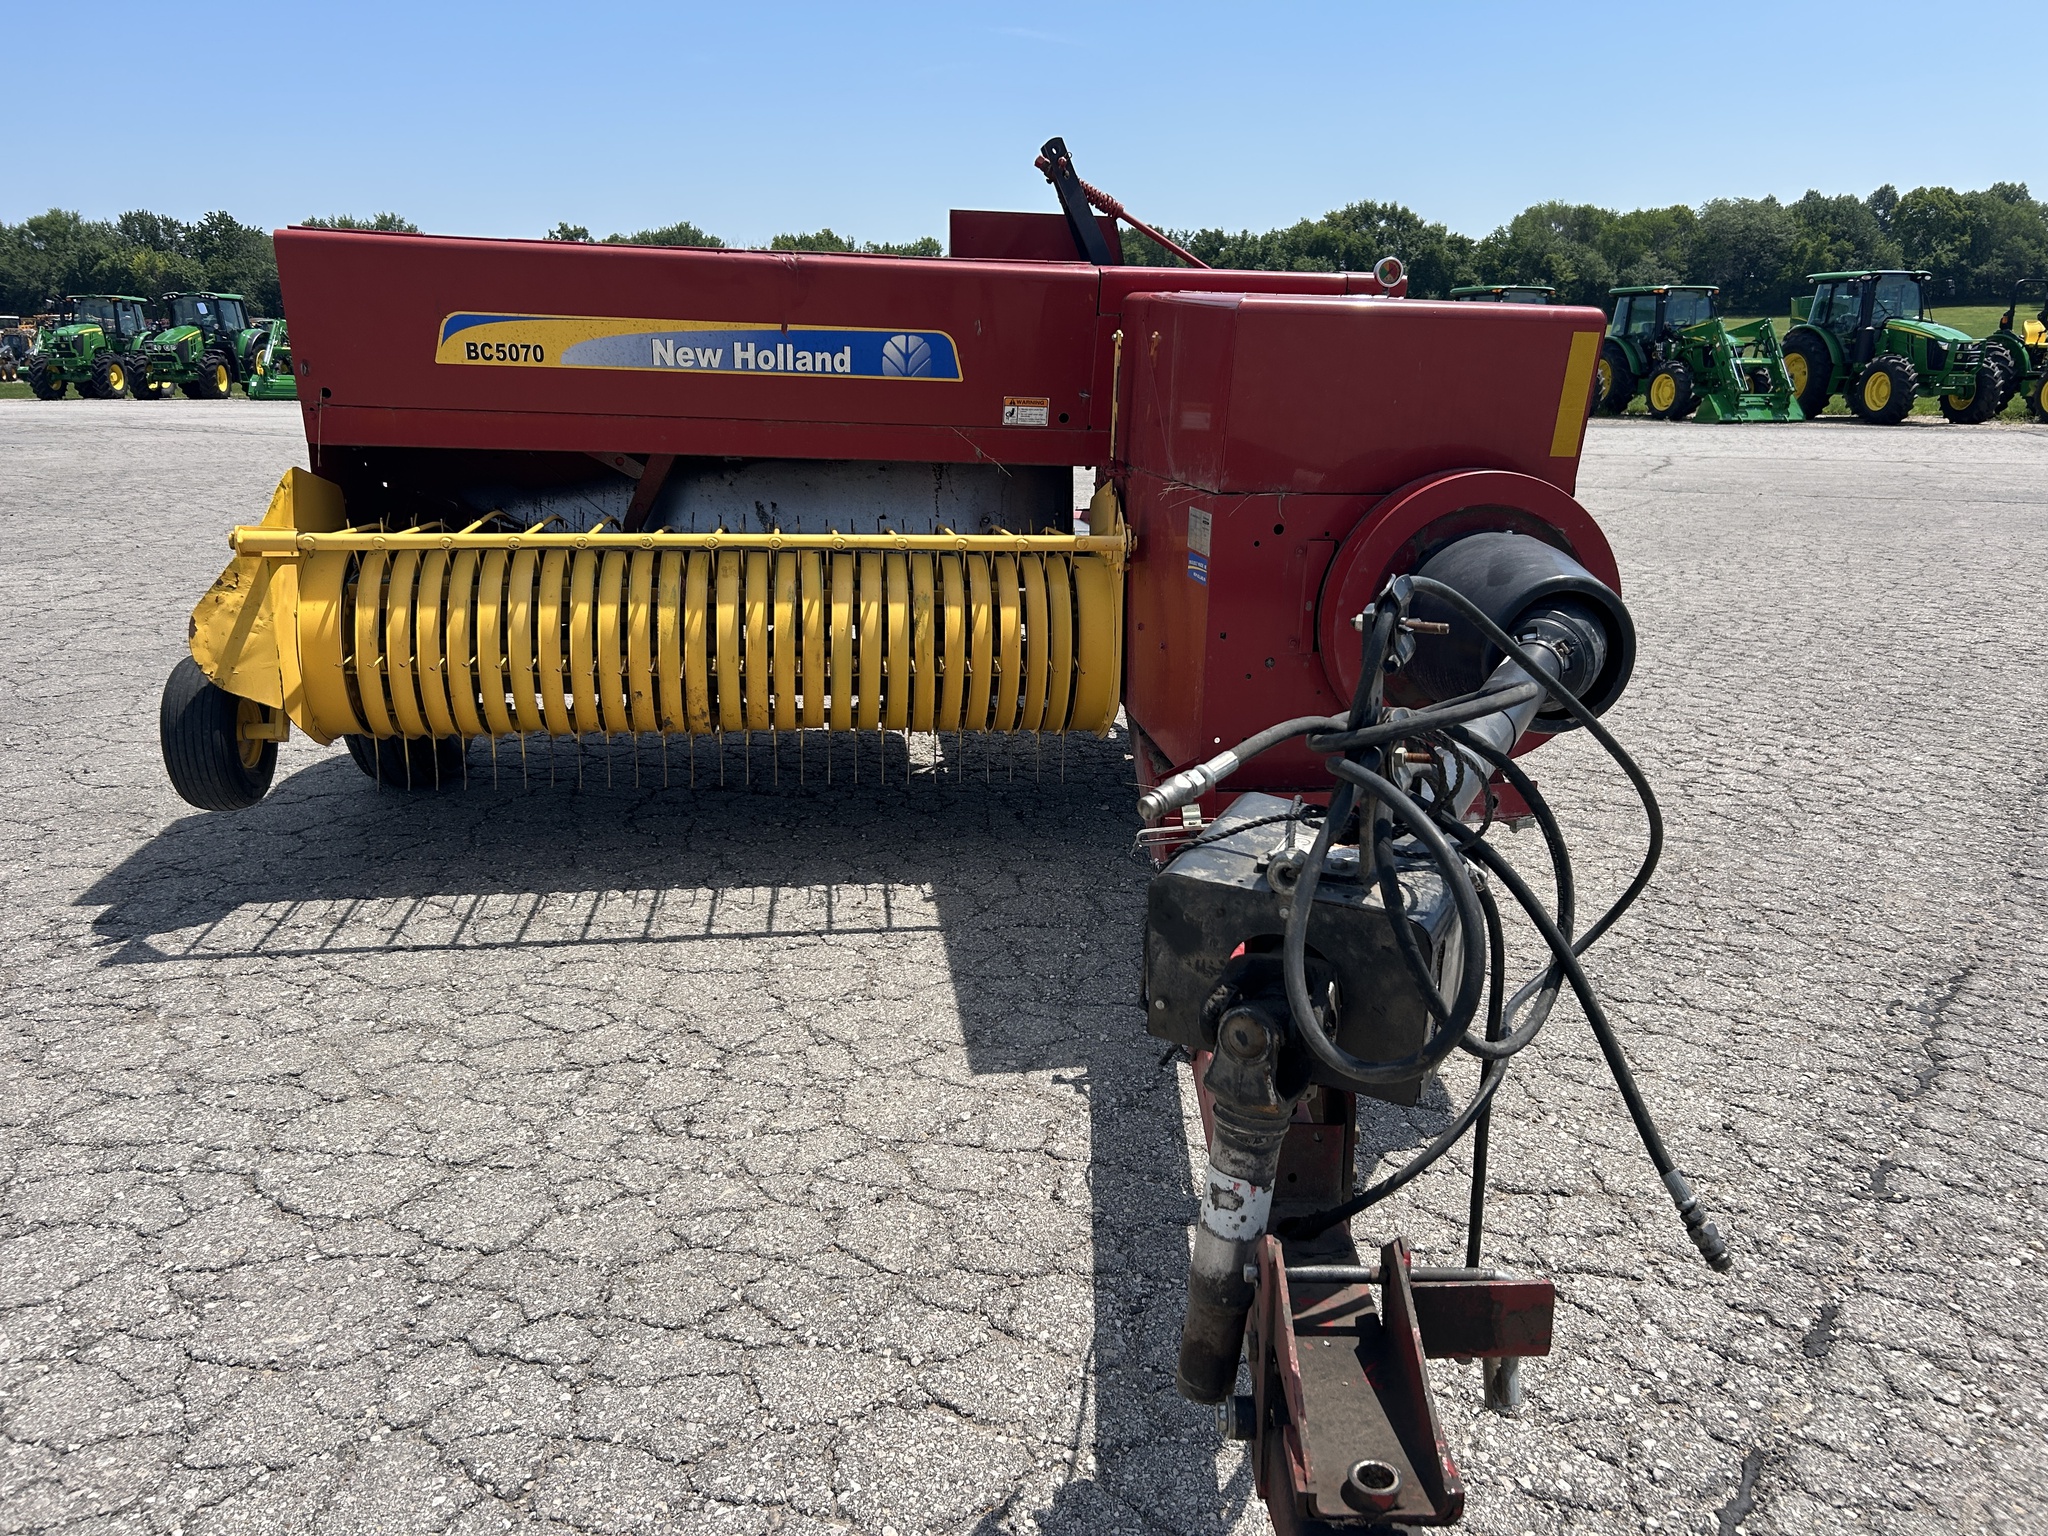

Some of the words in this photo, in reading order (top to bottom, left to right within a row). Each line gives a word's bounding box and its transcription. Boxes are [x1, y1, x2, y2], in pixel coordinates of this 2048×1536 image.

[465, 342, 545, 362] BC5070
[651, 338, 723, 368] New
[733, 342, 851, 373] Holland
